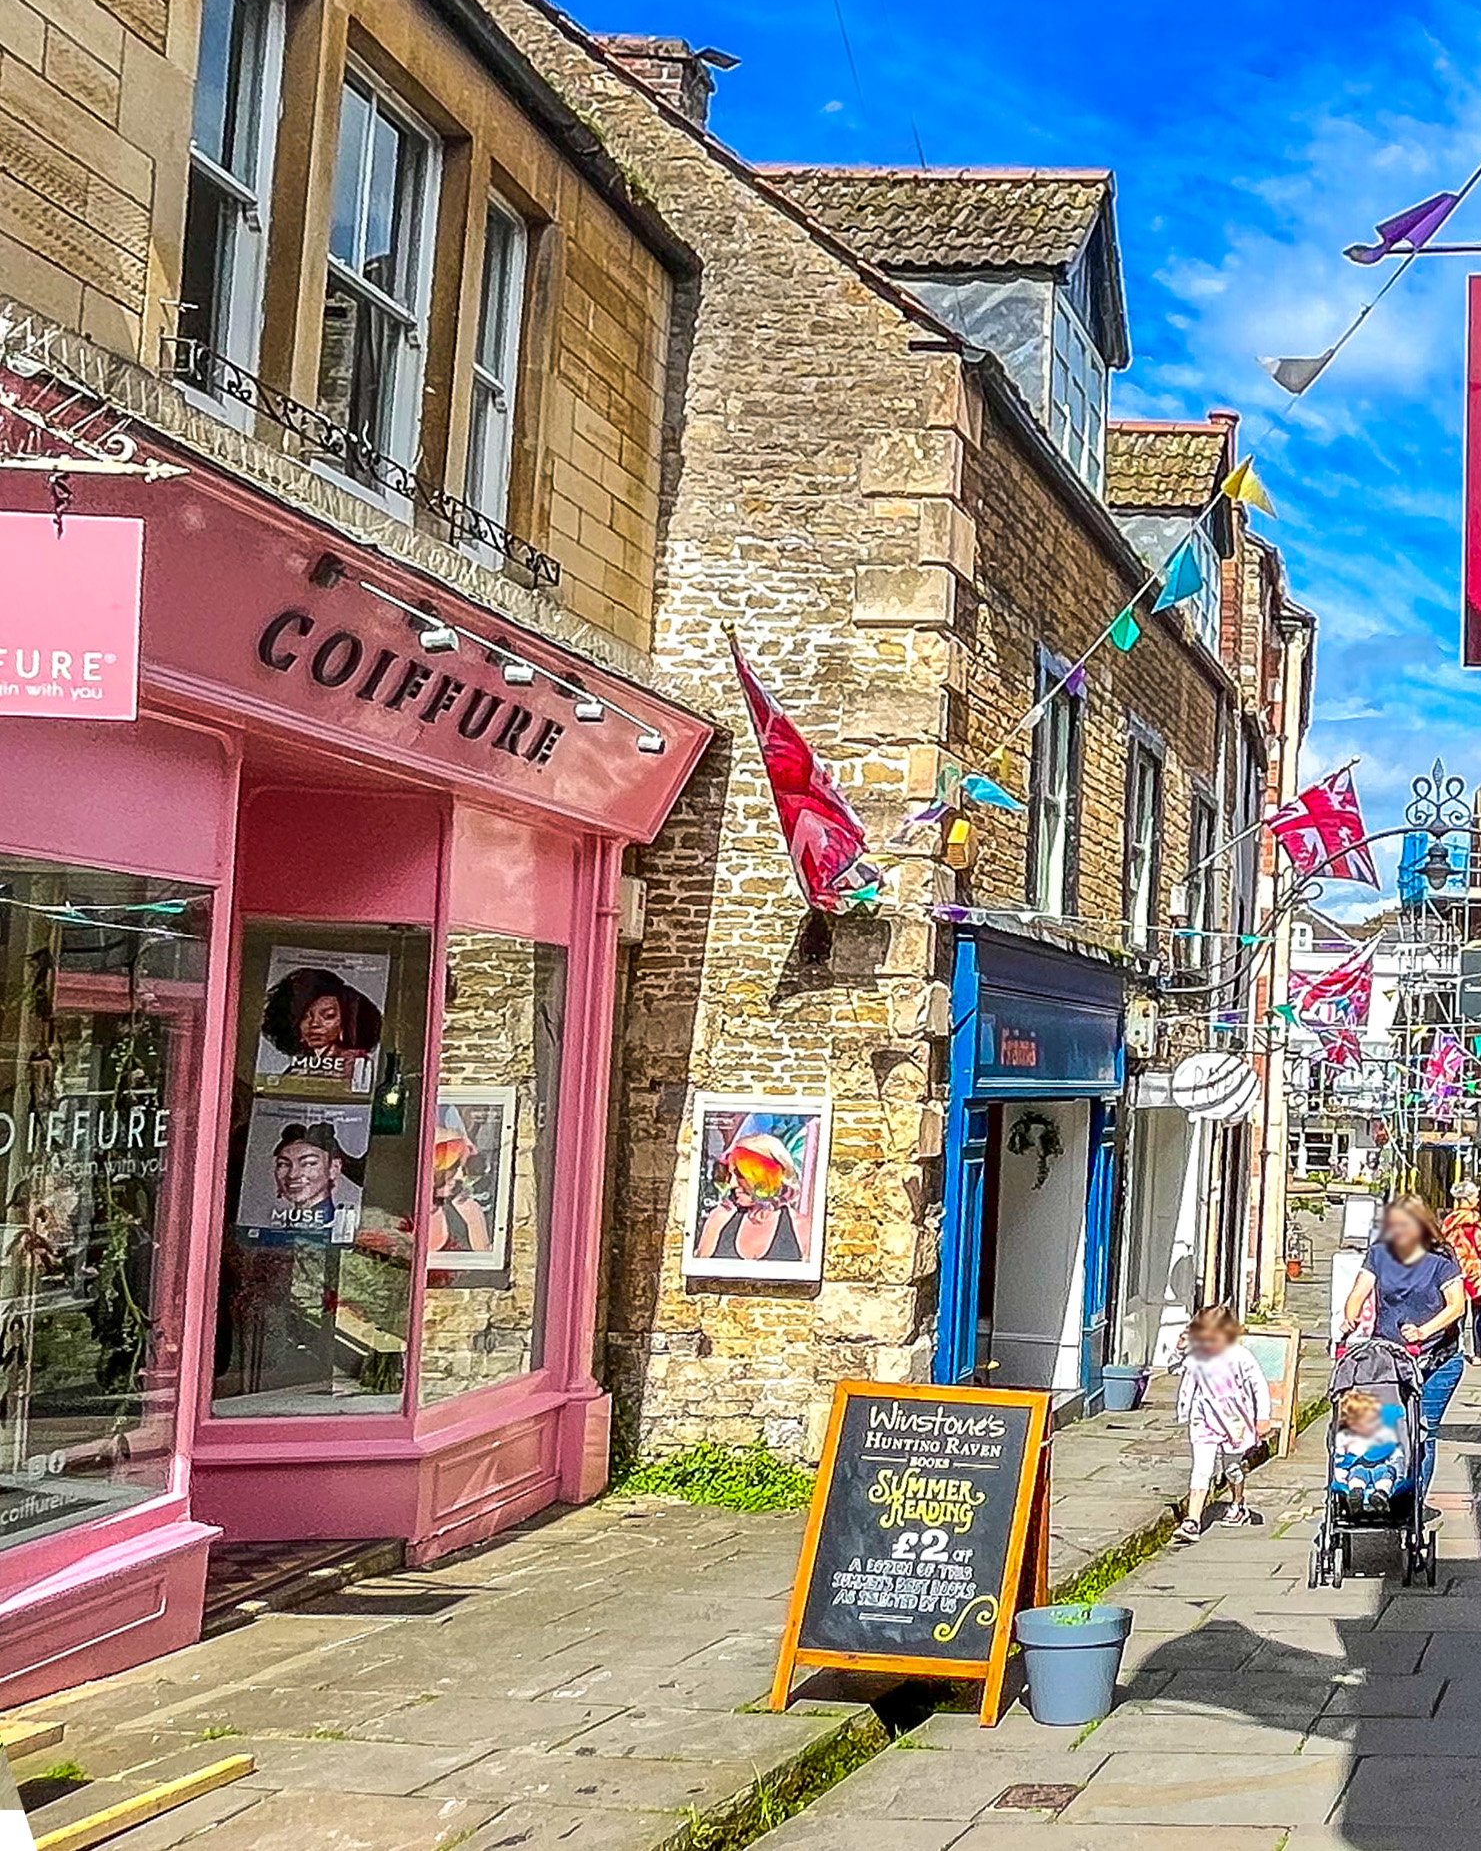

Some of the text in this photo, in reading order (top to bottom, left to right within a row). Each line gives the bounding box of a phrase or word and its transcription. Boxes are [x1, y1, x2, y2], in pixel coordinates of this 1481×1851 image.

[25, 681, 64, 697] with
[70, 687, 103, 701] you
[258, 609, 565, 765] COIFFURE
[291, 1055, 345, 1071] MUSE
[271, 1209, 325, 1223] MUSE
[869, 1402, 1006, 1438] Winstone's
[864, 1431, 1002, 1458] HUNTING RAVEN
[910, 1456, 950, 1468] BOOKS
[868, 1468, 986, 1506] SUMMER
[879, 1495, 974, 1534] READING
[892, 1528, 950, 1562] £2
